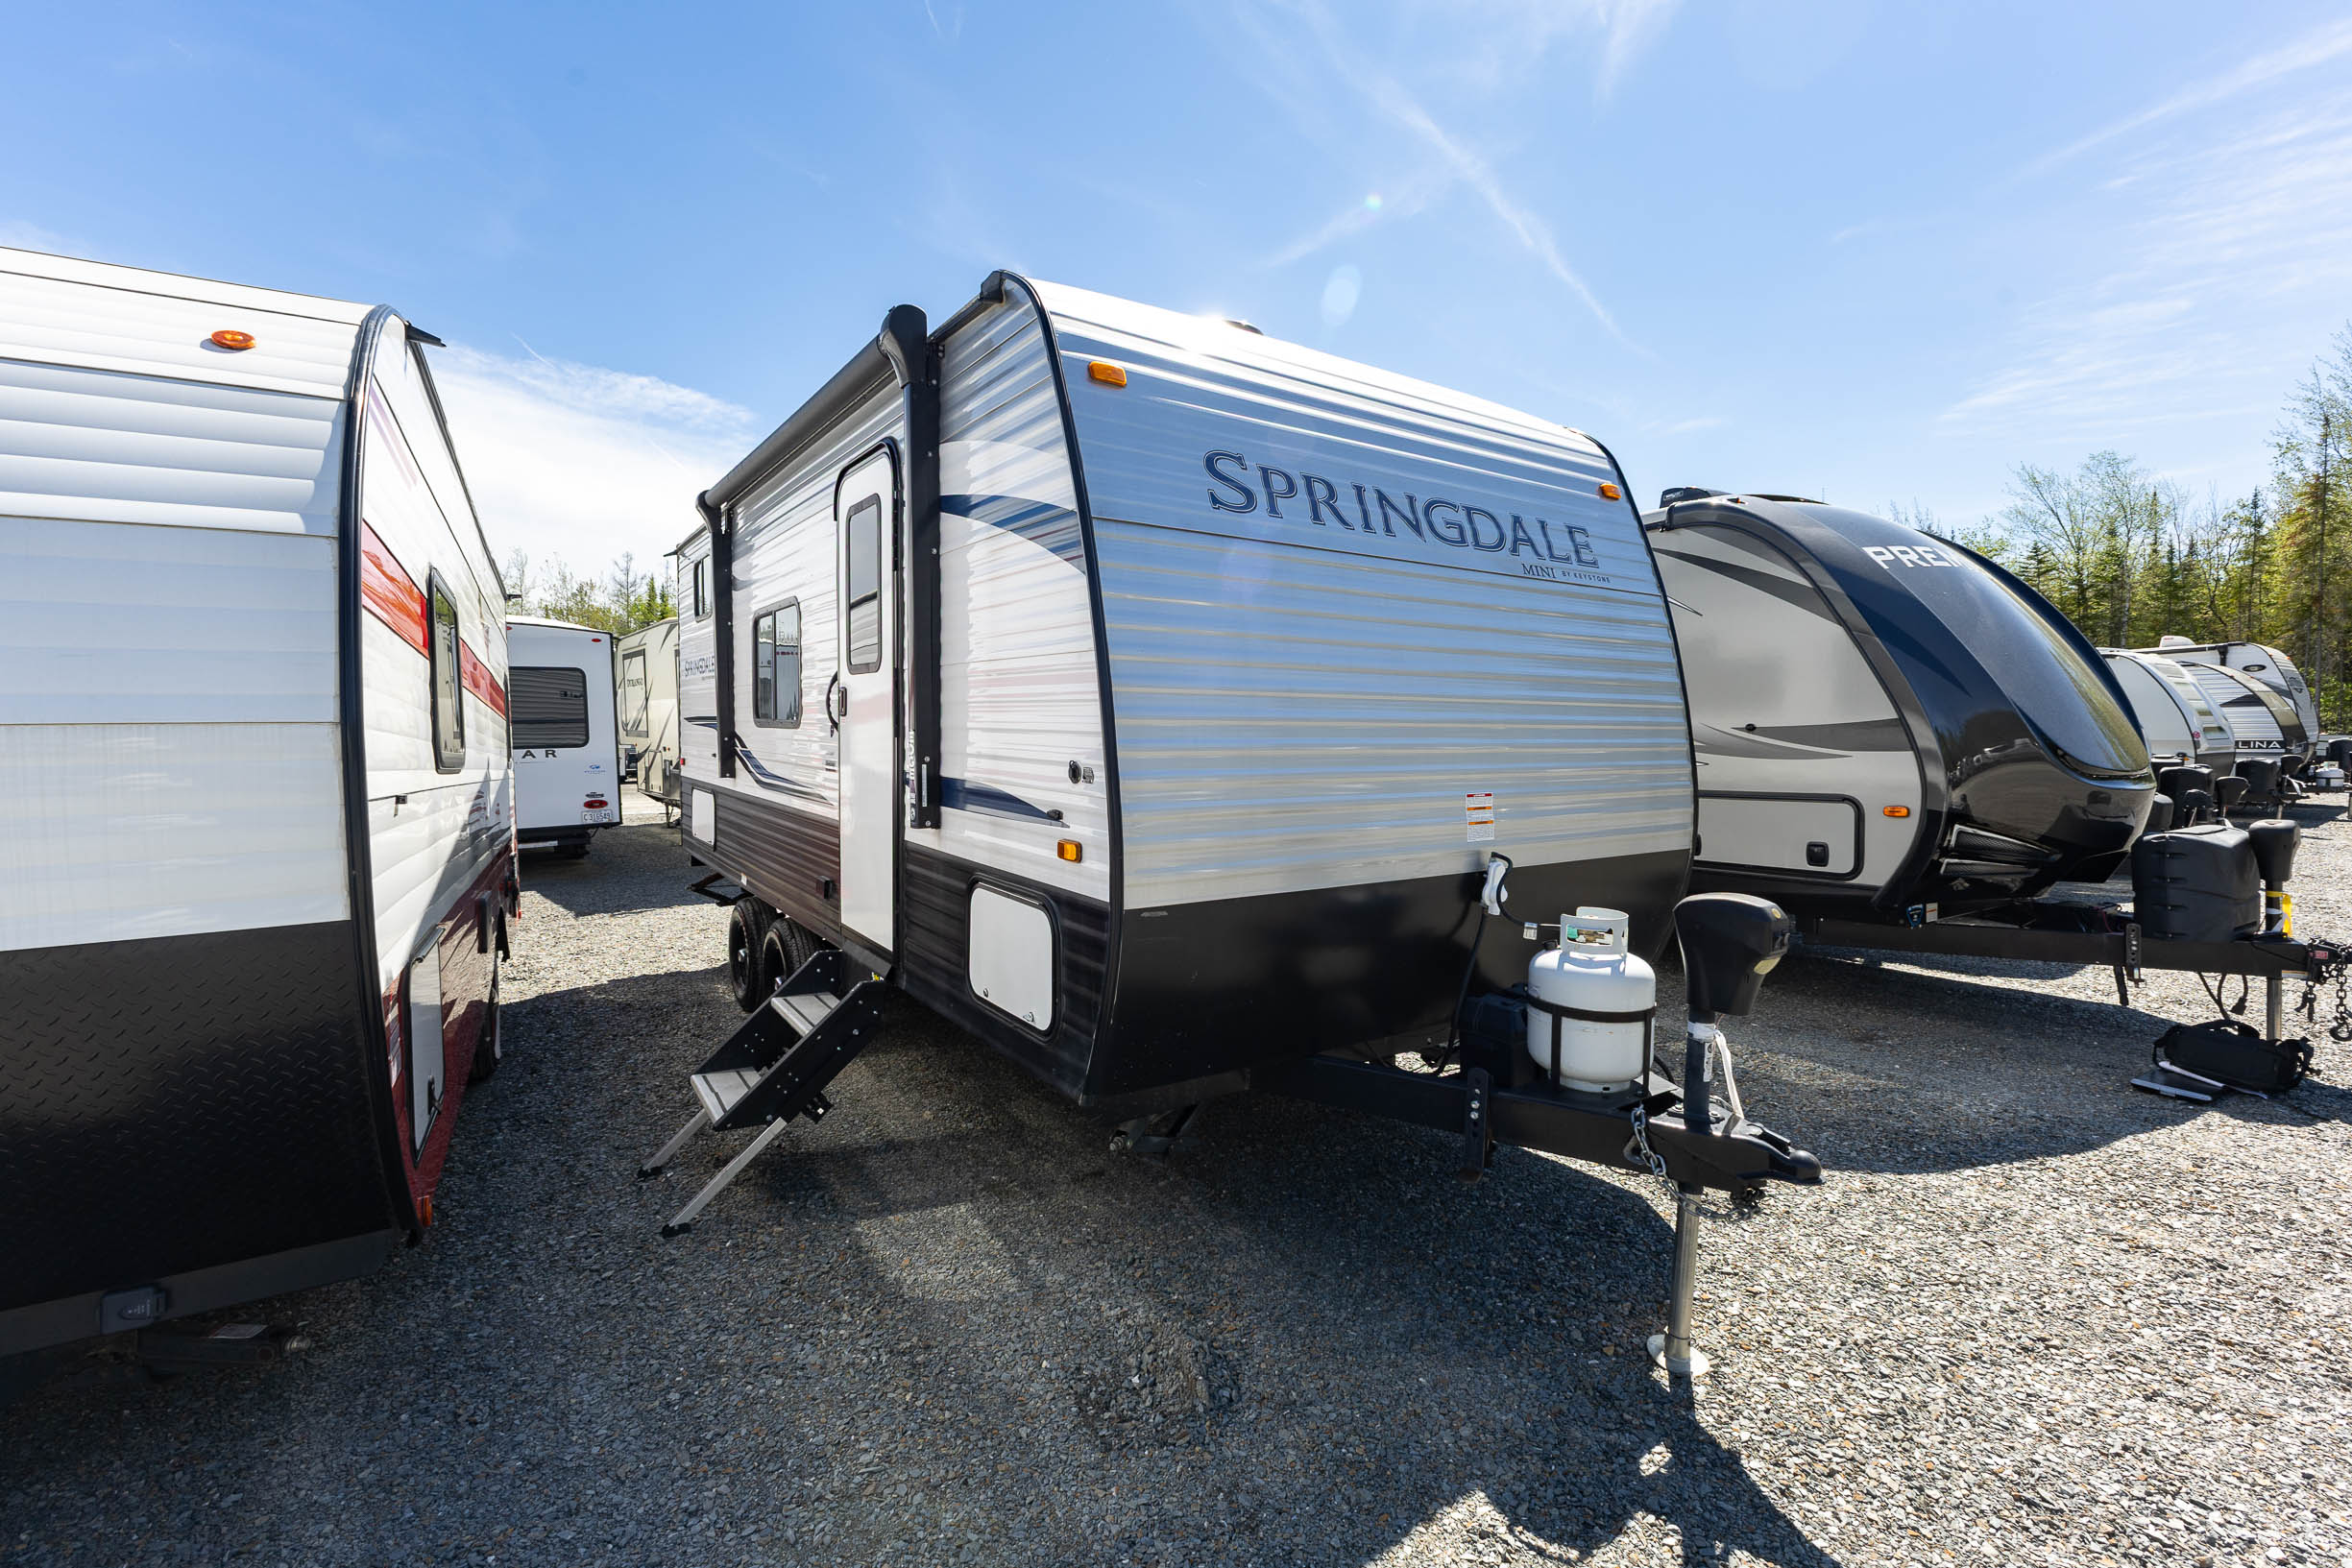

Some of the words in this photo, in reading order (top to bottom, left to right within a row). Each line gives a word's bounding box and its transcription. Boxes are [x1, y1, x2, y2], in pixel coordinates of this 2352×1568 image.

[1202, 449, 1600, 568] SPRINGDALE
[1521, 564, 1557, 578] MINI
[1574, 572, 1611, 583] KEYSTONE
